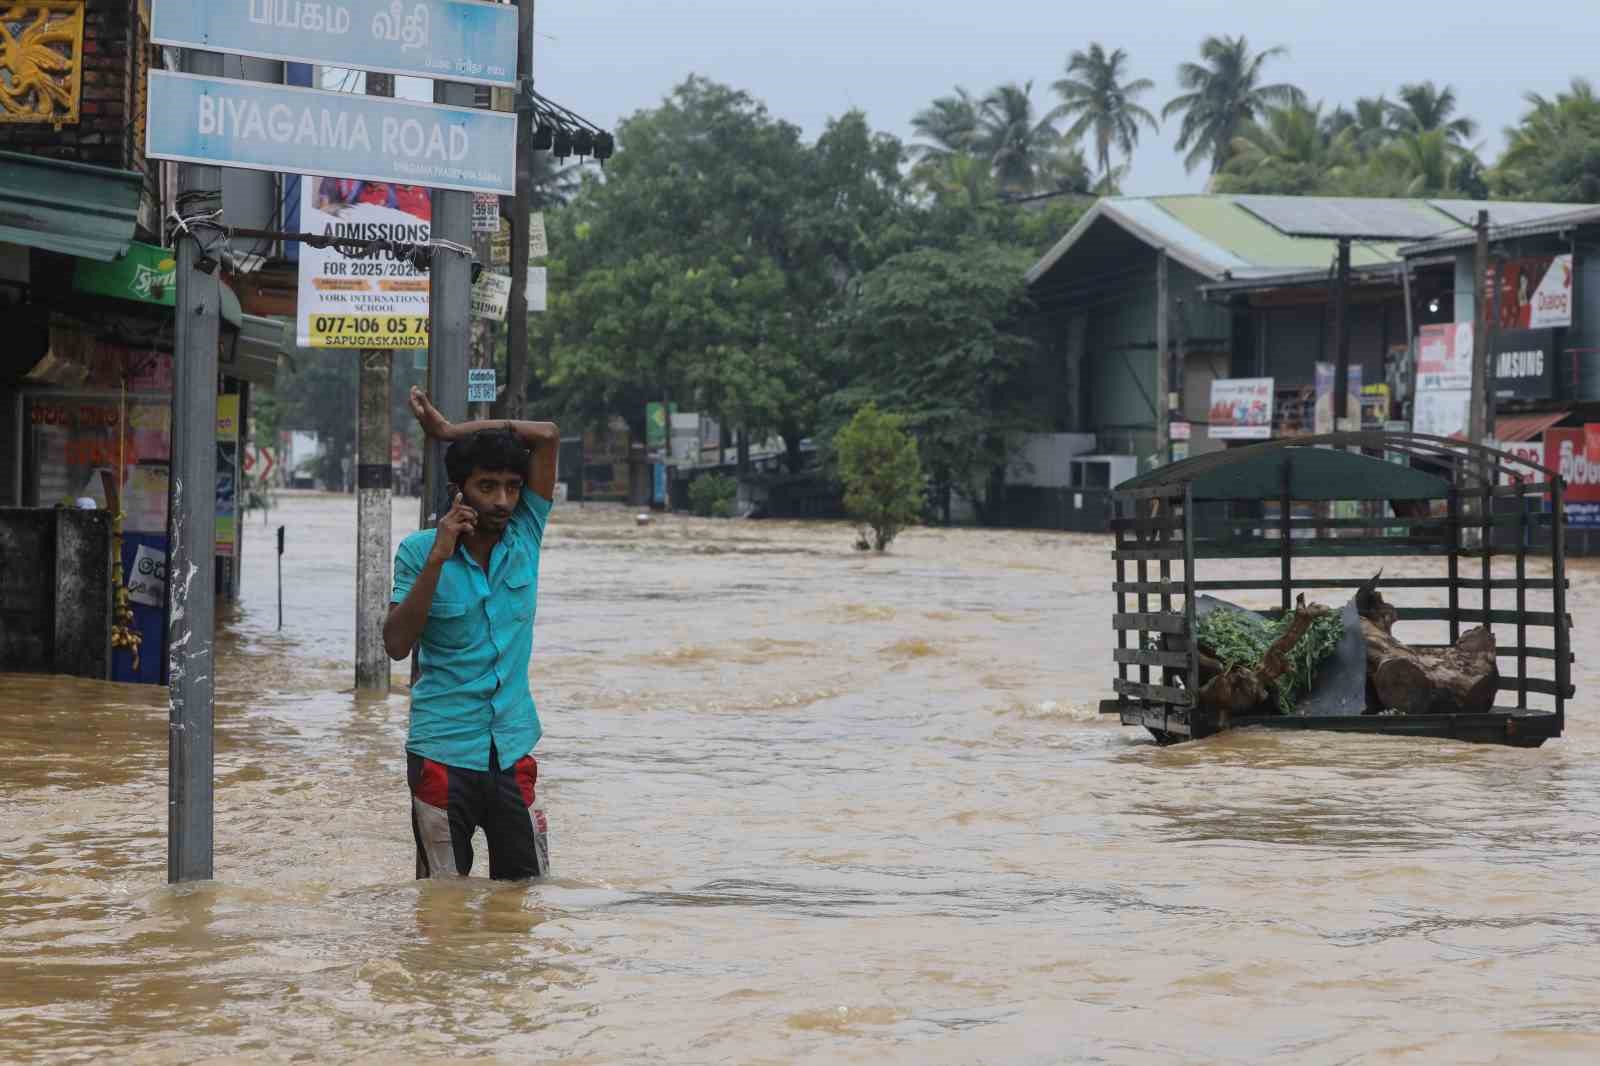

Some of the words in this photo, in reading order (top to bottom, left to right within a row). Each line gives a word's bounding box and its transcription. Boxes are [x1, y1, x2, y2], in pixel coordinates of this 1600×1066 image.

[198, 94, 372, 153] BIYAGAMA
[381, 116, 469, 161] ROAD
[324, 222, 429, 242] ADMISSIONS
[323, 262, 347, 276] FOR
[351, 262, 422, 276] 2025/202
[320, 294, 347, 302] YORK
[354, 303, 394, 312] SCHOOL
[316, 316, 380, 333] 077-106
[386, 318, 407, 333] 05
[325, 335, 425, 346] SAPUGASKANDA
[1487, 350, 1544, 378] MSUNG
